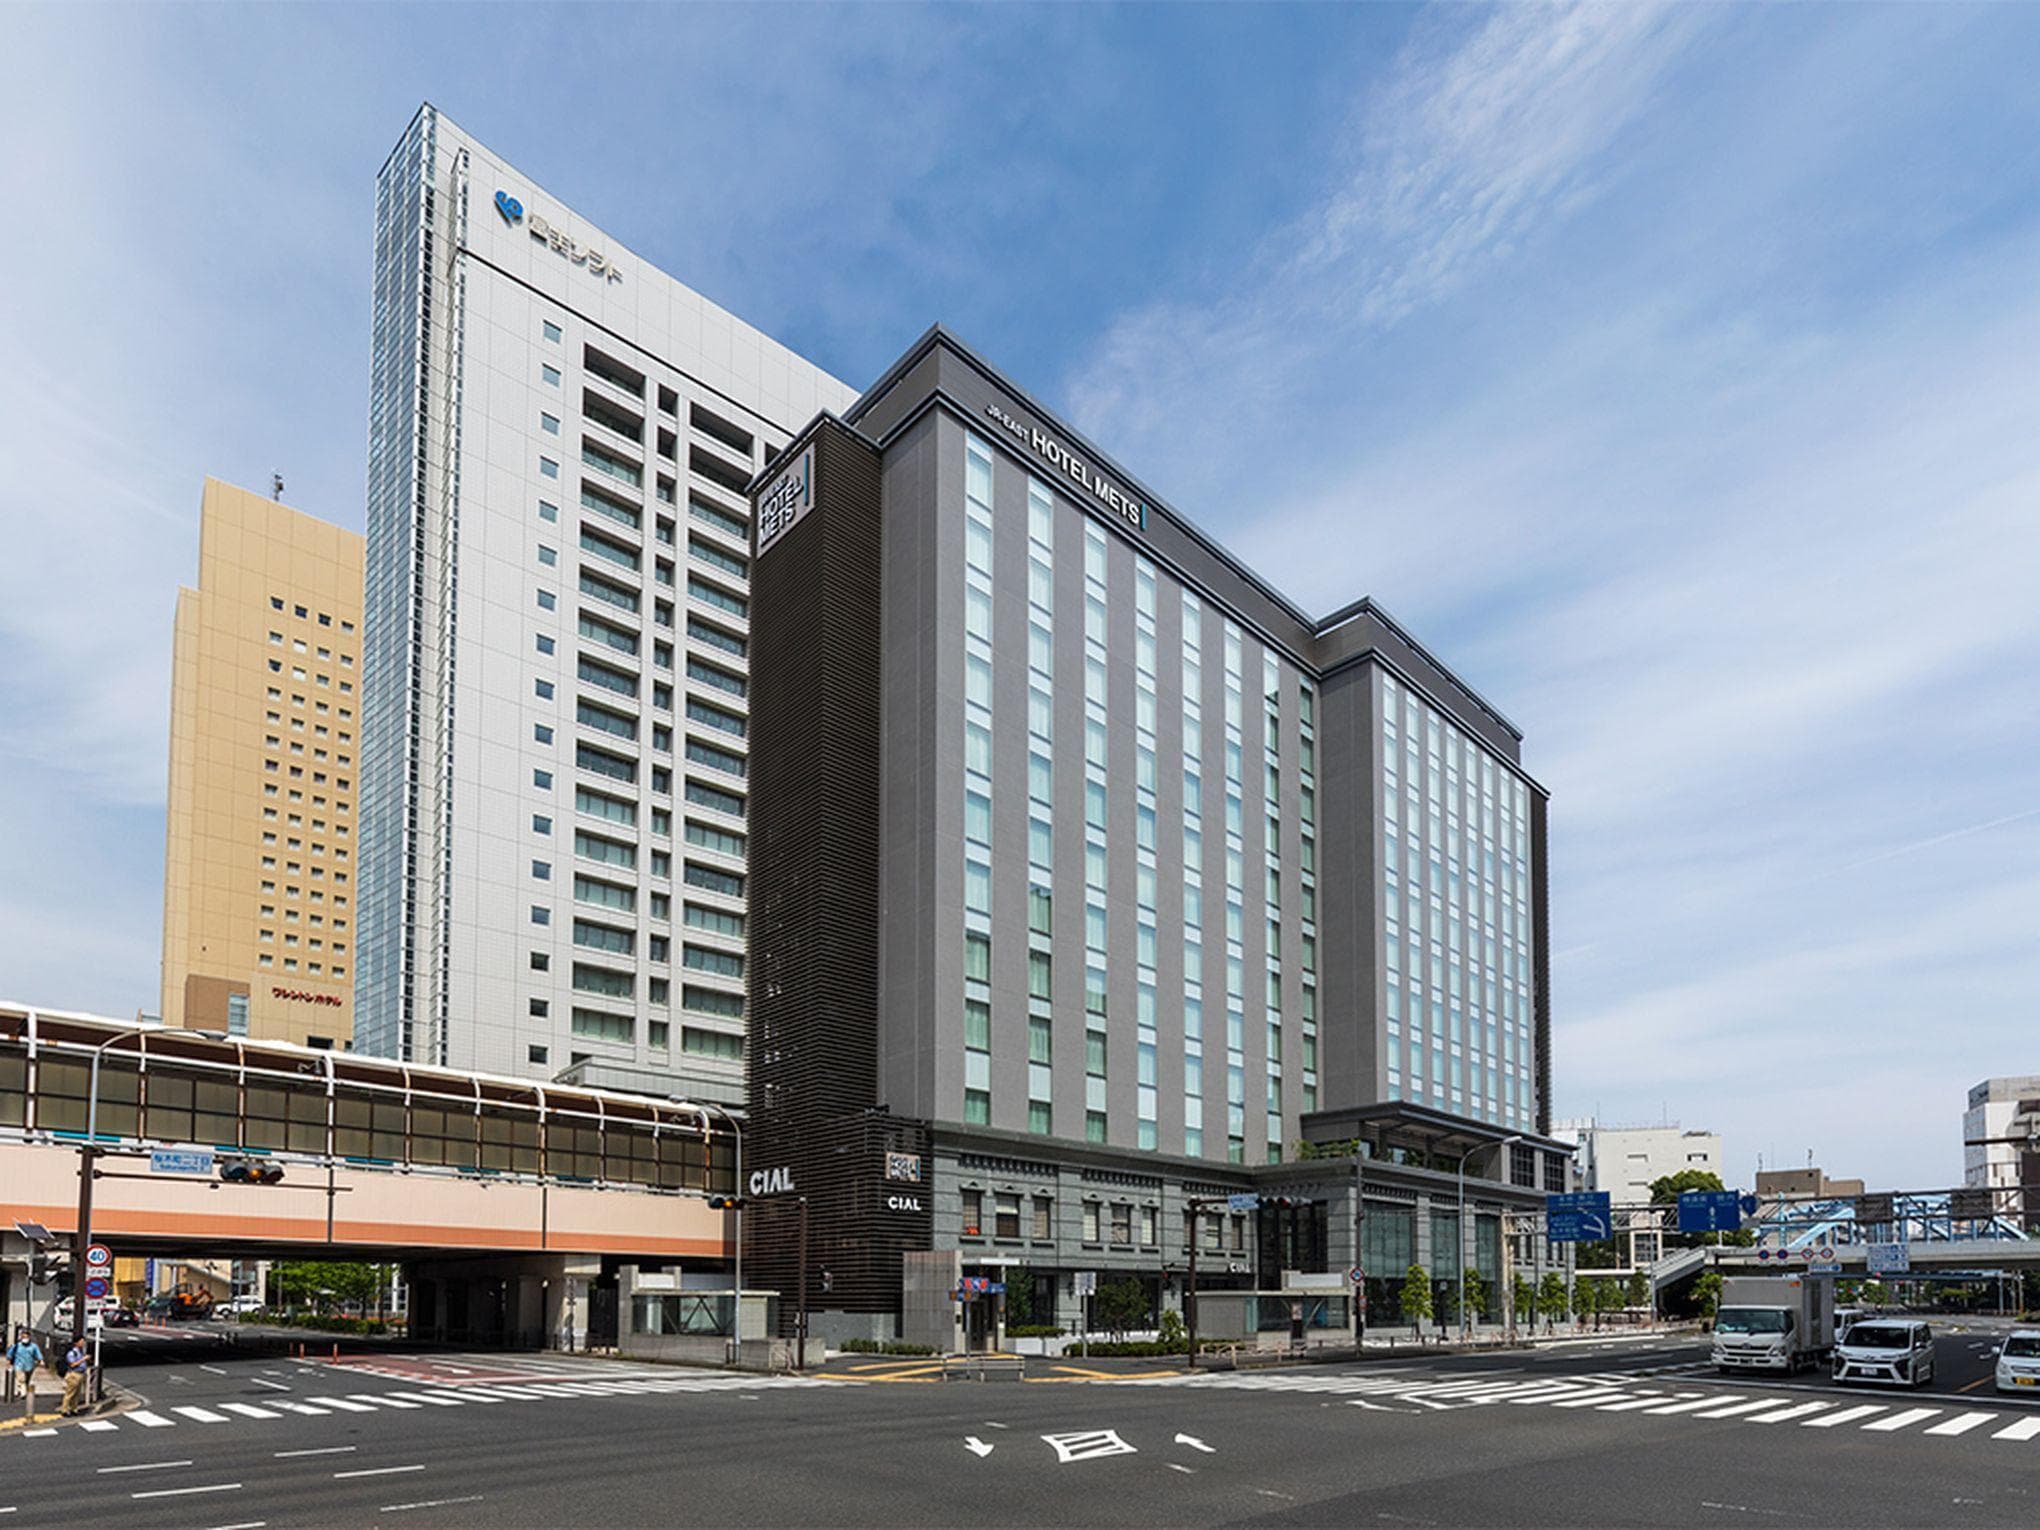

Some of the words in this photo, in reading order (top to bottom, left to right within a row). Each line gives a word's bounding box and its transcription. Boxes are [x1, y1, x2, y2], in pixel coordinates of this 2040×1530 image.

[1032, 427, 1093, 491] HOTEL
[1095, 476, 1140, 525] METS
[760, 475, 803, 527] HOTEL
[750, 1166, 795, 1195] CIAL
[888, 1196, 922, 1211] CIAL
[90, 1250, 106, 1262] 40
